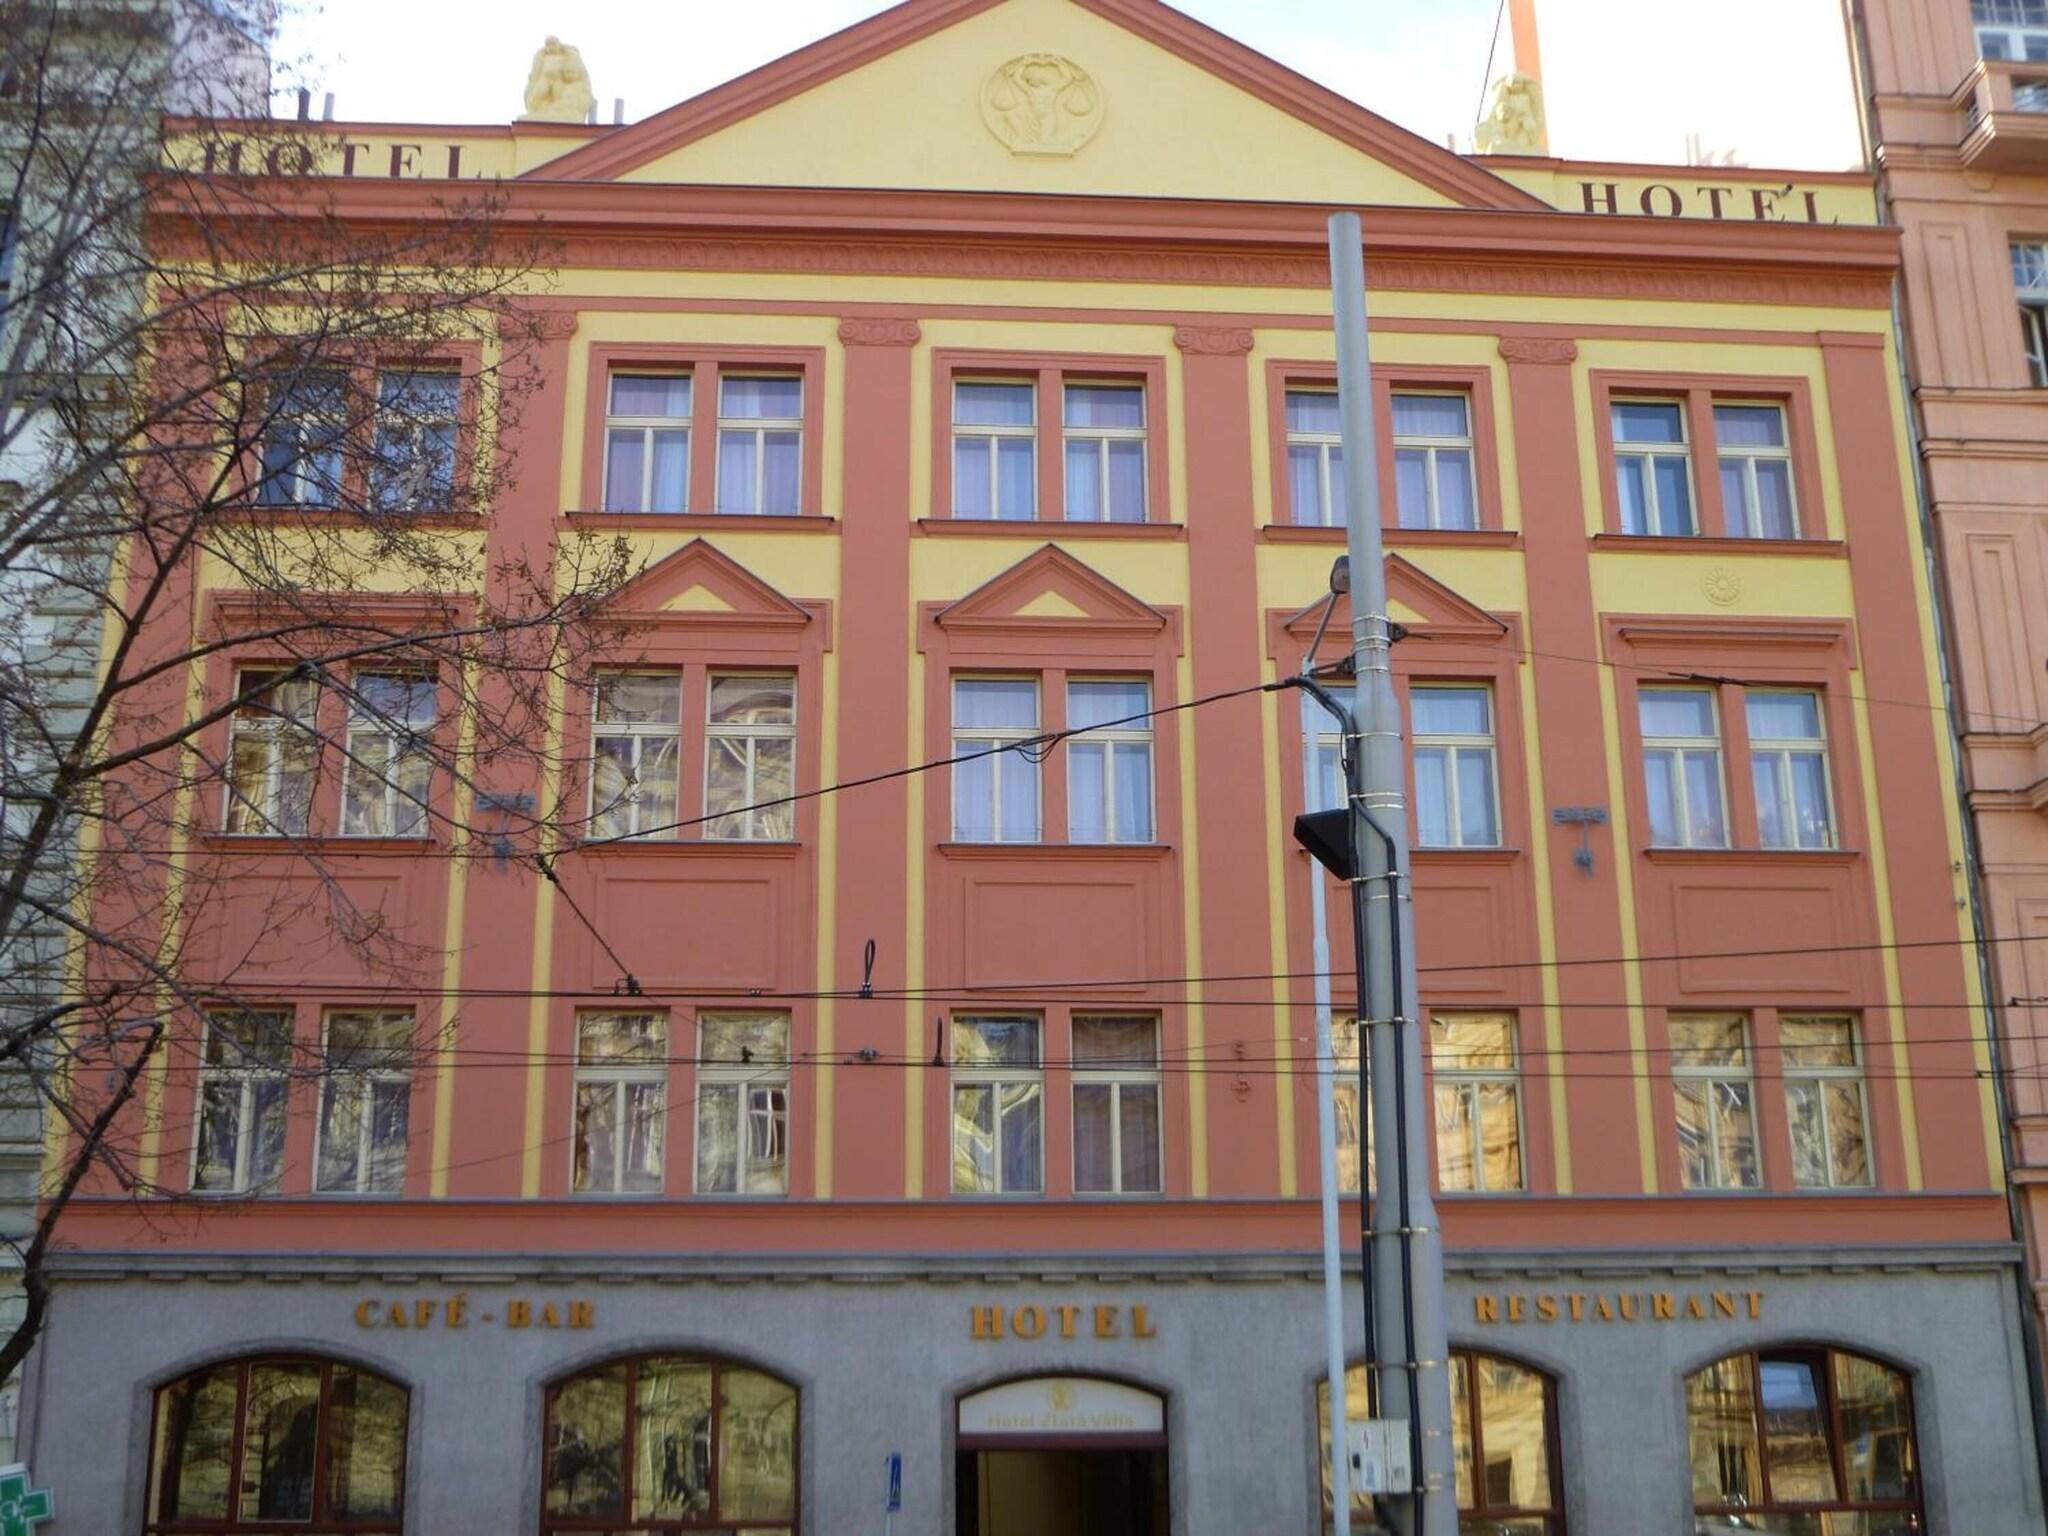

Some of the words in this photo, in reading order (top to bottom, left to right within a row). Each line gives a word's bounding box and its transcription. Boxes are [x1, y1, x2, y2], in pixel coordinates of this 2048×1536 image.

[206, 141, 483, 179] HOTEL
[1579, 181, 1838, 225] HOTEL
[354, 1293, 467, 1329] CAFÉ
[506, 1299, 595, 1329] BAR
[969, 1304, 1158, 1341] HOTEL
[1475, 1290, 1764, 1322] RESTAURANT
